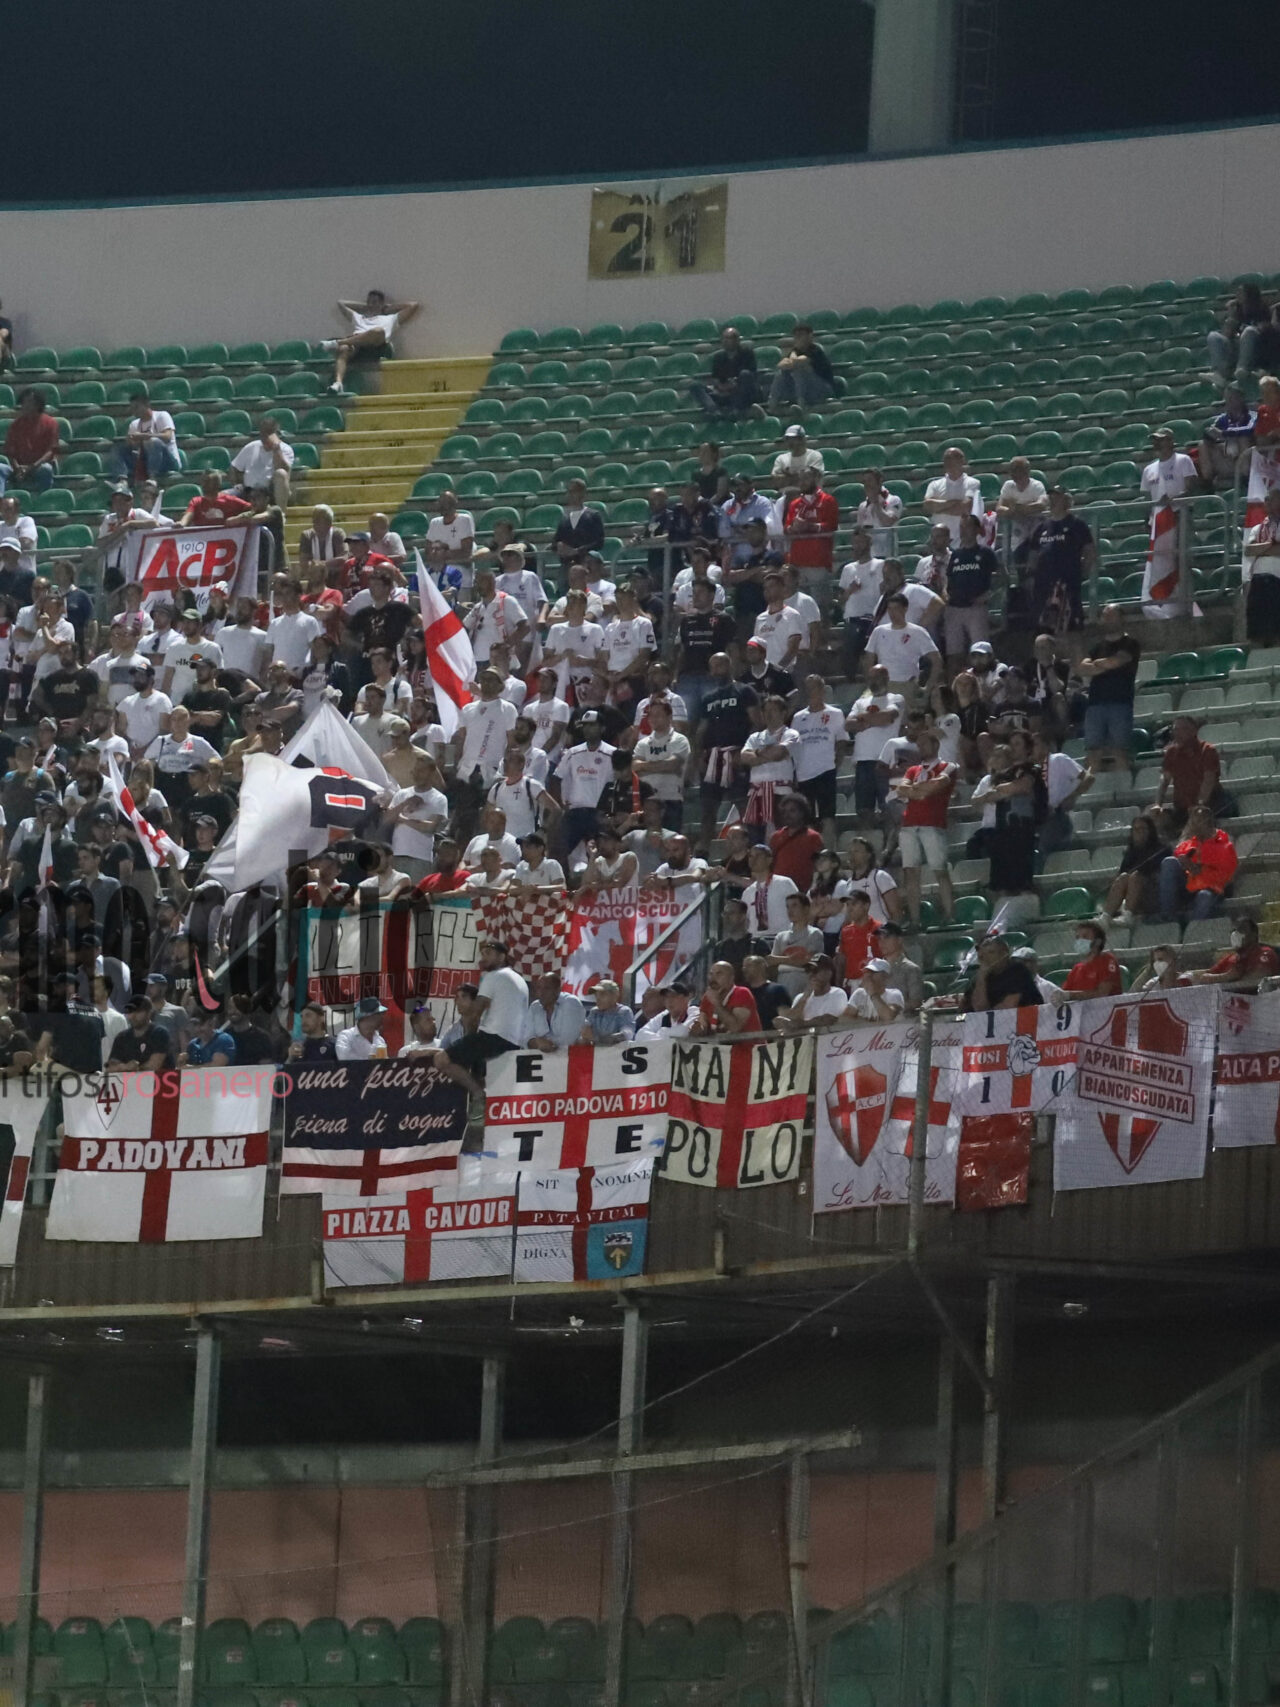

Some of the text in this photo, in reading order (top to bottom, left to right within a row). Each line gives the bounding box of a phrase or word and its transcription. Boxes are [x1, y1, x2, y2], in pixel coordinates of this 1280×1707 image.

[825, 1032, 855, 1058] La
[297, 1067, 349, 1090] una
[1082, 1048, 1185, 1087] APPARTENENZA
[1221, 1057, 1262, 1078] ALTA
[488, 1089, 668, 1121] CALCIO PADOVA 1910
[1082, 1079, 1190, 1115] BIANCOSCUDATA
[290, 1109, 456, 1139] piena di sogni
[77, 1138, 246, 1170] PADOVANI
[535, 1168, 652, 1191] SIT NOMINE
[327, 1199, 510, 1236] PIAZZA CAVOUR
[533, 1207, 635, 1225] PATAVIUM
[522, 1247, 568, 1260] DIGNA
